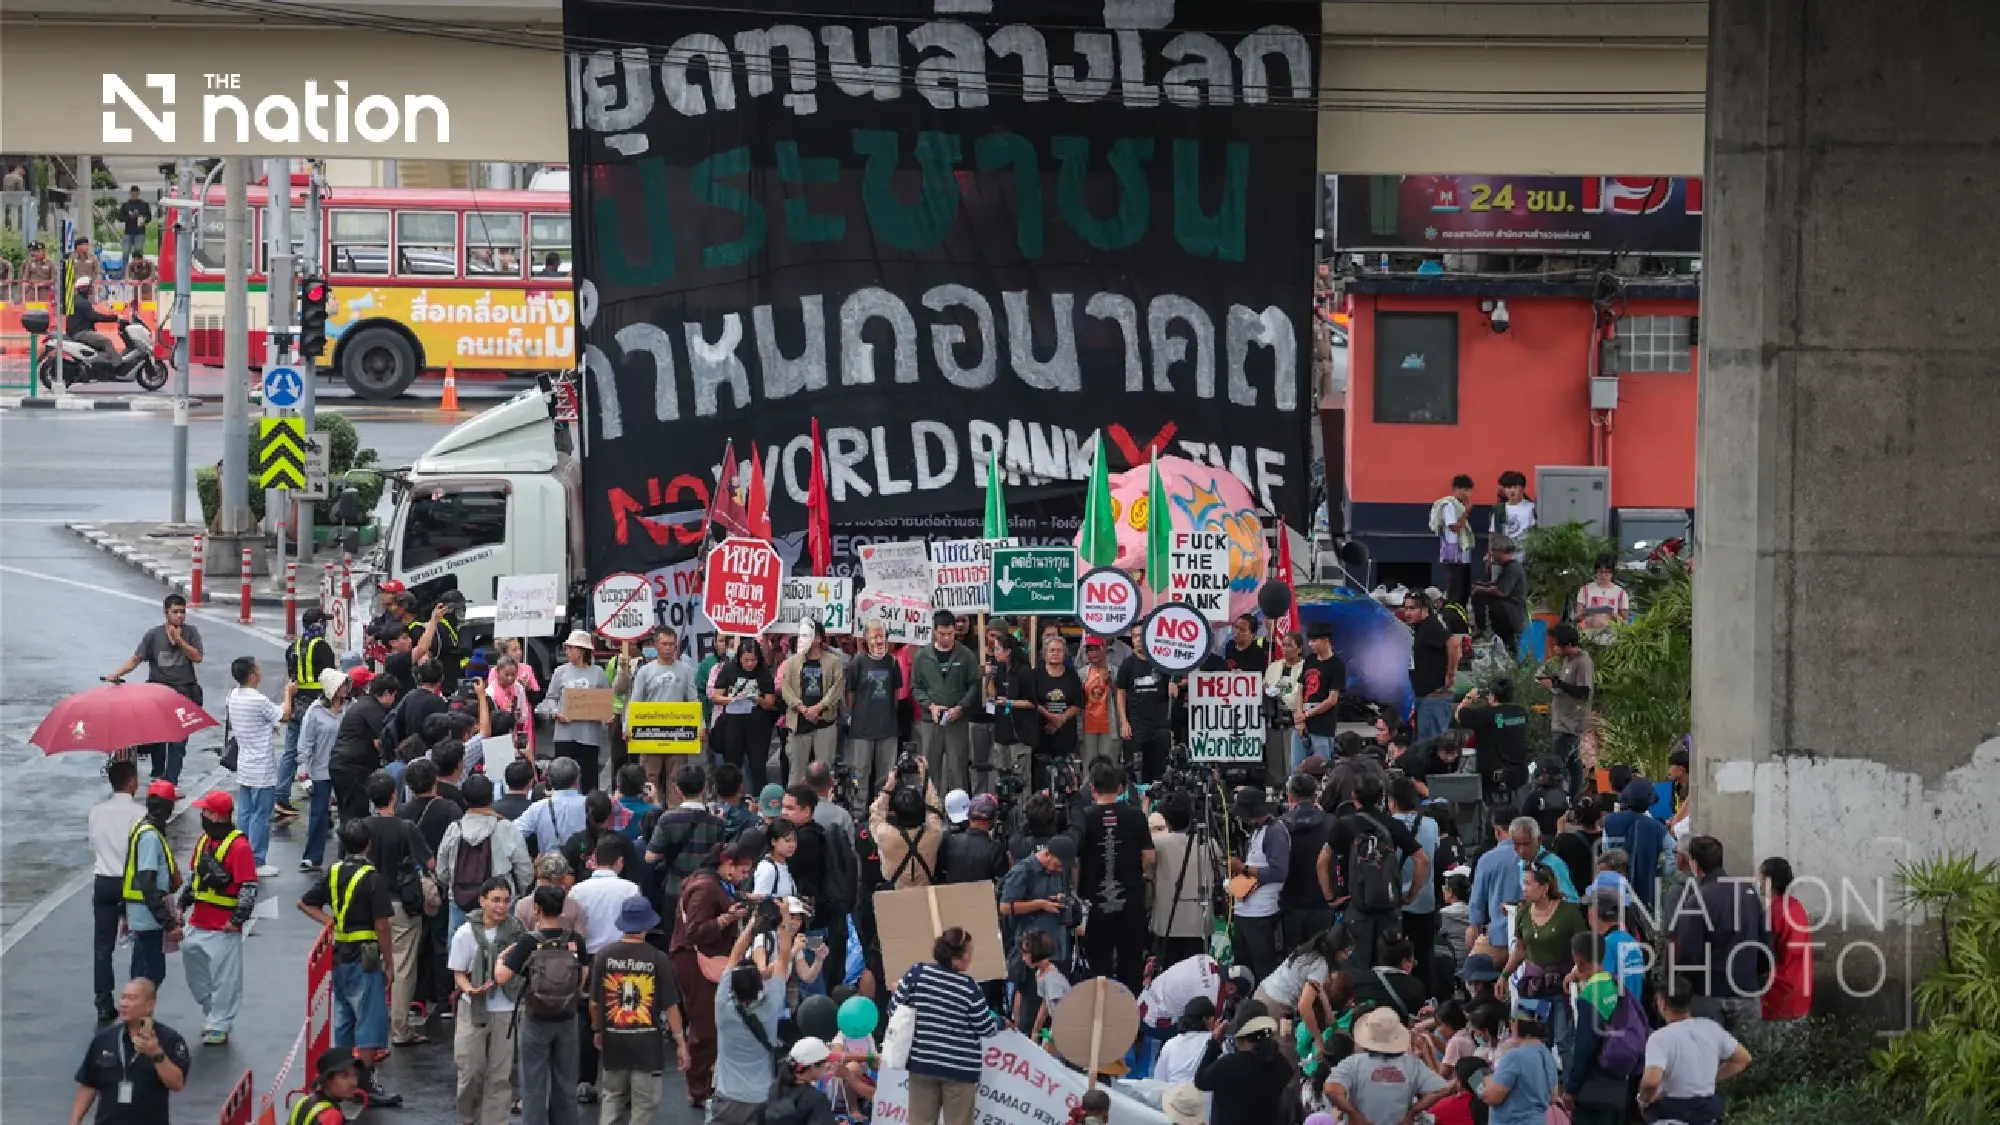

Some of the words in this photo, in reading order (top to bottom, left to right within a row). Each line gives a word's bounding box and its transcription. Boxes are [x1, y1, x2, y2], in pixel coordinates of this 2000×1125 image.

[598, 128, 1249, 281] ประชาชน
[1470, 184, 1515, 212] 24
[1527, 190, 1575, 212] ชม.
[608, 474, 709, 545] NO
[1176, 533, 1227, 550] FUCK
[722, 545, 770, 582] หยุด
[1172, 553, 1212, 570] THE
[817, 581, 830, 602] 4
[1172, 573, 1229, 590] WORLD
[1087, 583, 1128, 604] NO
[880, 606, 900, 620] SAY
[905, 608, 920, 623] NO
[1086, 613, 1103, 622] NO
[1106, 614, 1126, 622] IMF
[1156, 616, 1199, 642] NO
[1154, 646, 1171, 657] NO
[1174, 649, 1195, 660] IMF
[1197, 676, 1257, 704] หยุด!
[607, 958, 627, 970] PINK
[627, 959, 655, 972] FLOYD
